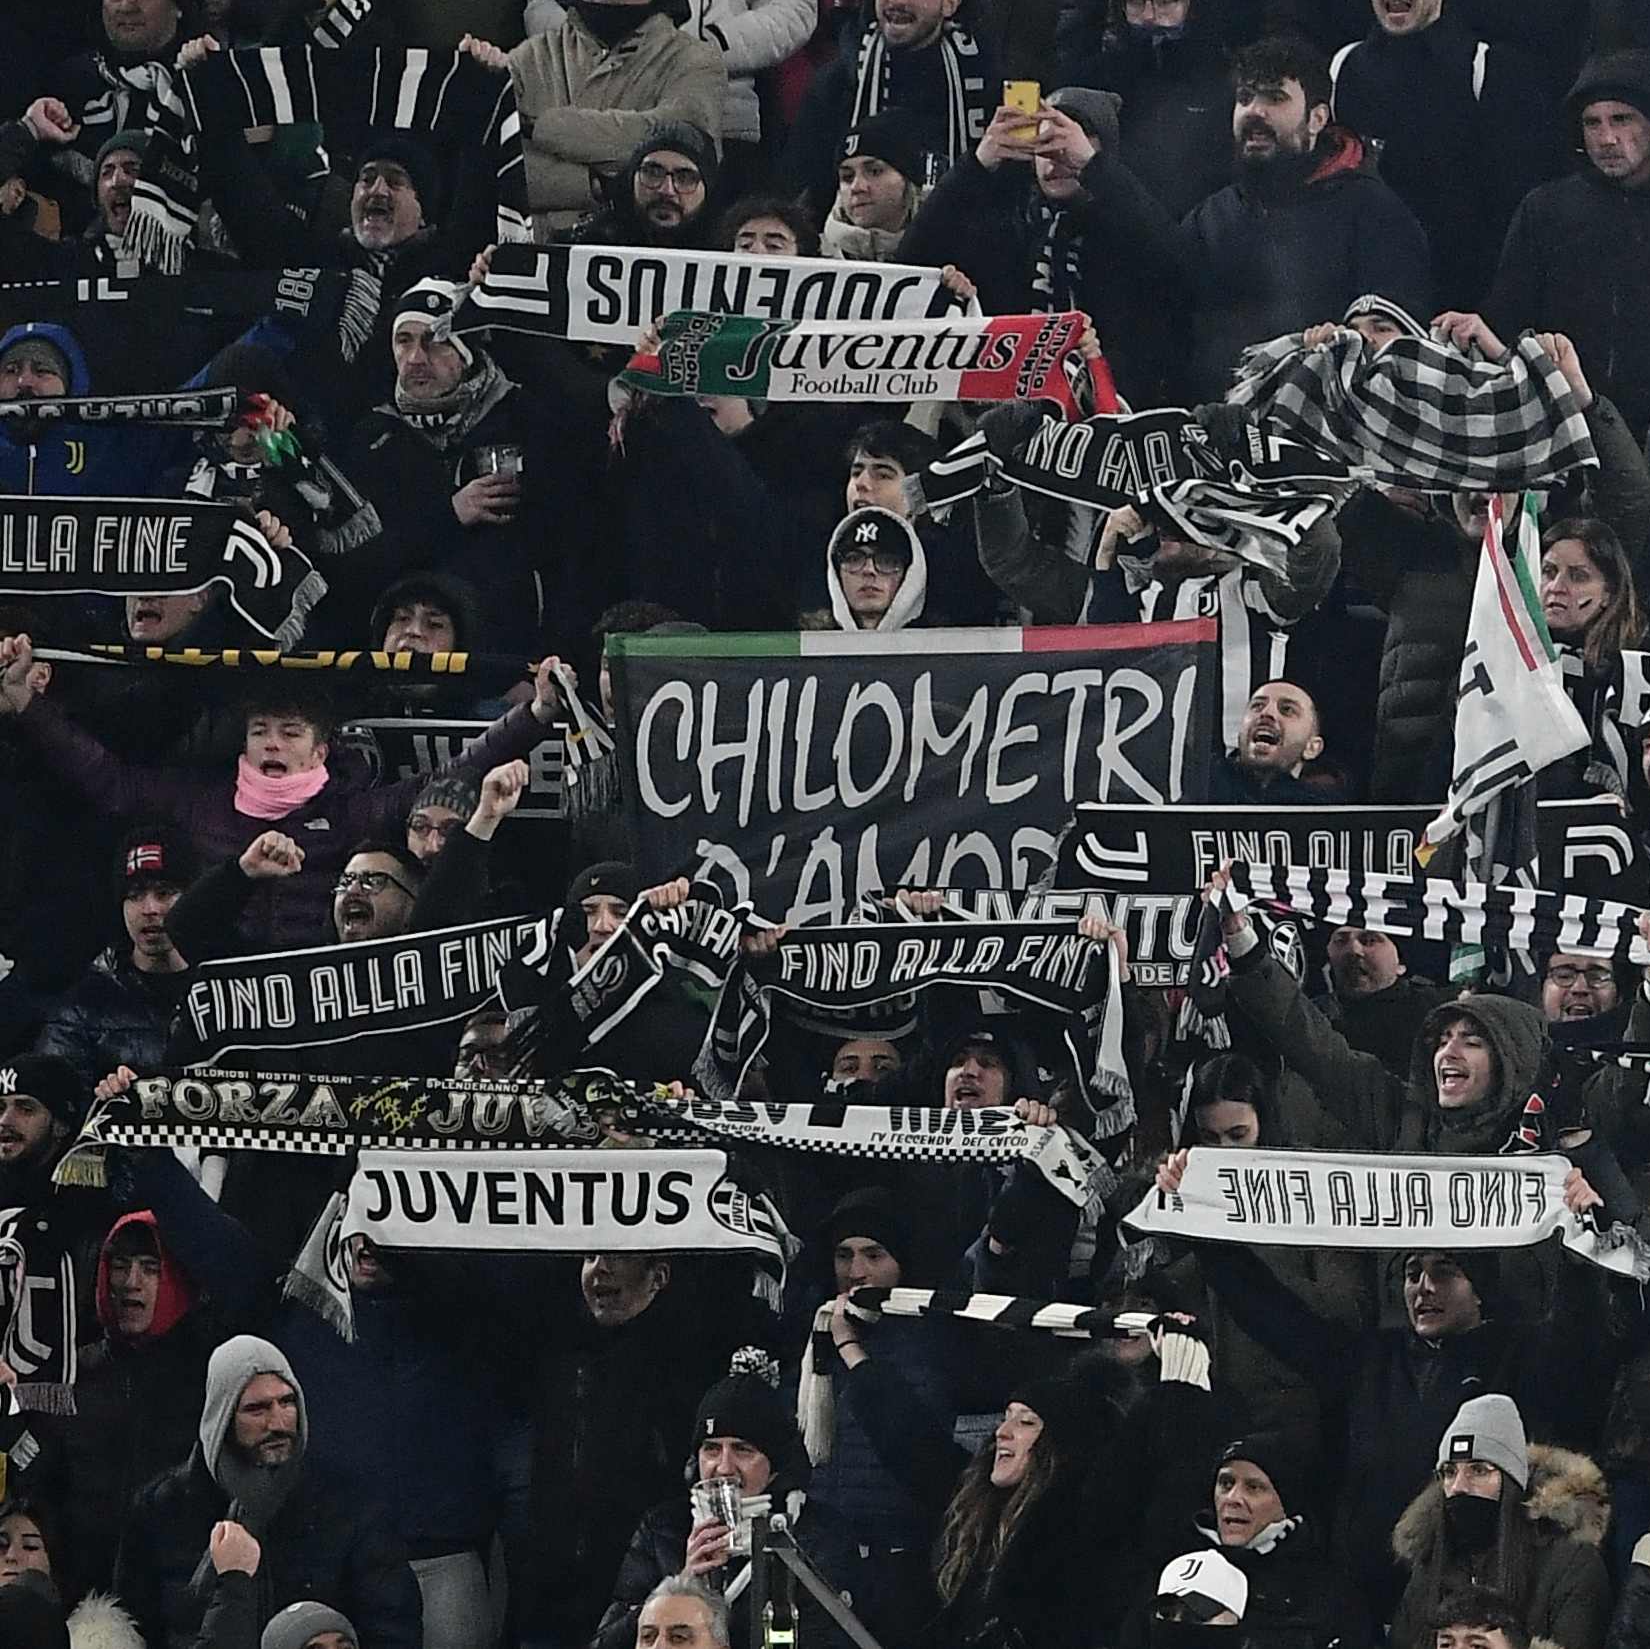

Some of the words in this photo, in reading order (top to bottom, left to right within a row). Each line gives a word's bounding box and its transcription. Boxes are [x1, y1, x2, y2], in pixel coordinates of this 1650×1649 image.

[726, 318, 1021, 382] Juventus
[788, 371, 880, 396] Football
[886, 370, 939, 395] Club
[92, 514, 194, 574] FINE
[636, 665, 1198, 829] CHILOMETRI
[779, 940, 882, 993] FINO
[889, 936, 1005, 984] ALLA
[187, 972, 296, 1043] FINO
[308, 949, 426, 1024] ALLA
[139, 1075, 350, 1132] FORZA
[194, 1068, 251, 1080] GLORIOSI
[256, 1071, 302, 1083] NOSTRI
[308, 1073, 353, 1085] COLORI
[425, 1080, 520, 1093] SPLENDERANNO
[364, 1169, 694, 1227] JUVENTUS
